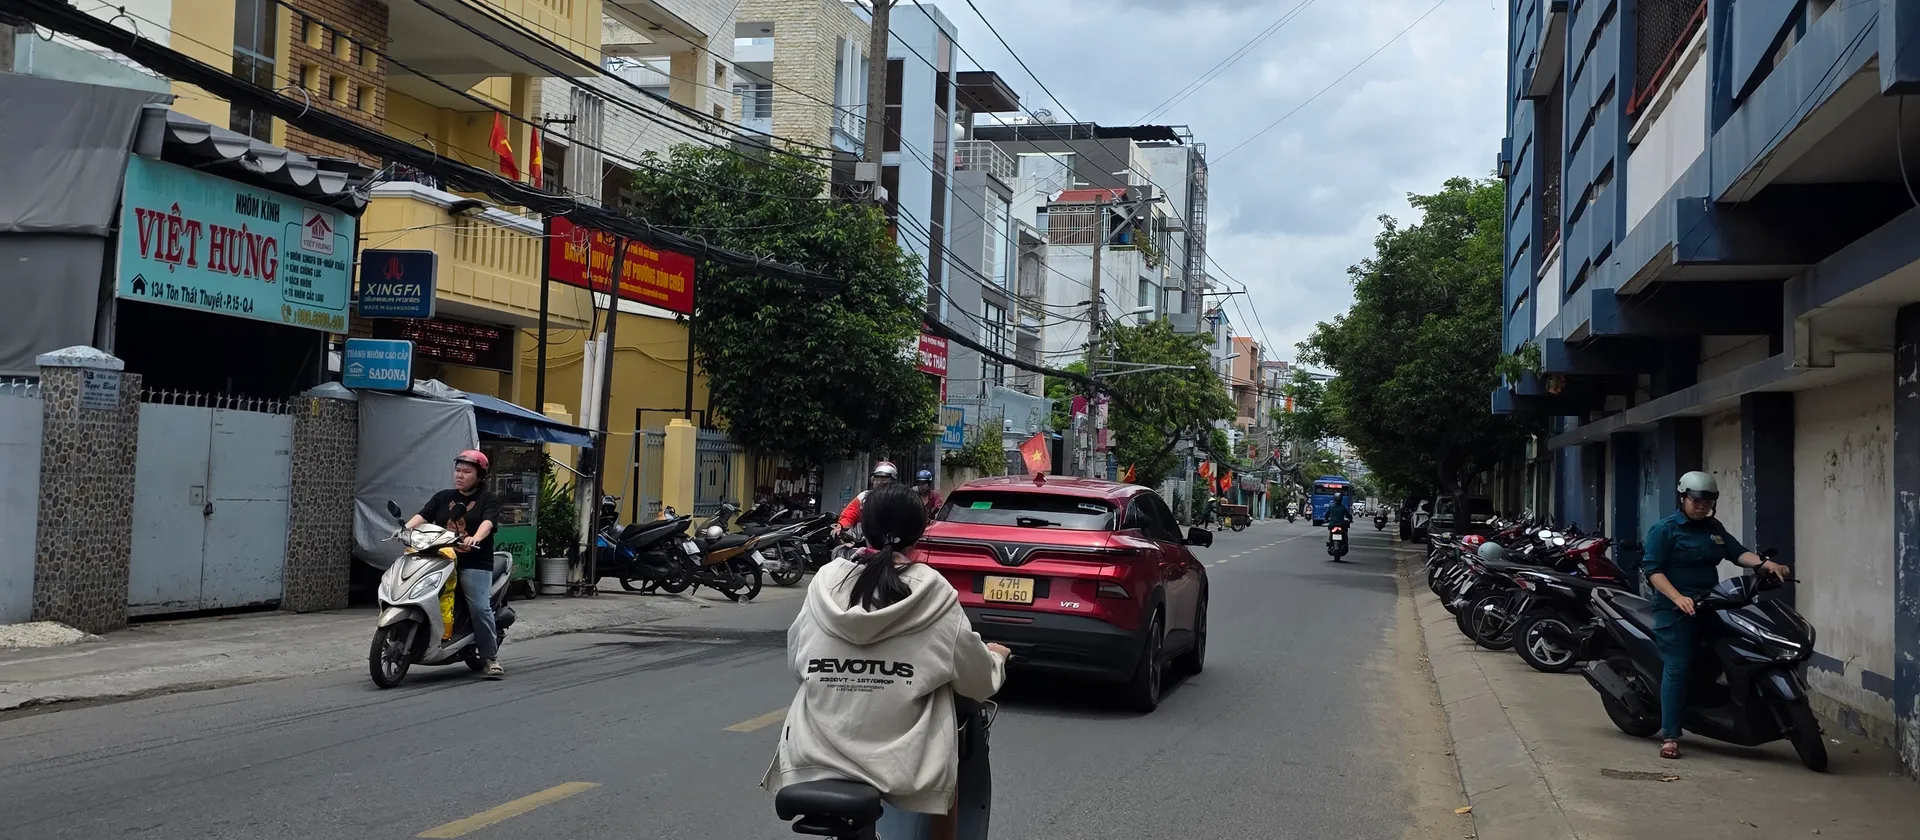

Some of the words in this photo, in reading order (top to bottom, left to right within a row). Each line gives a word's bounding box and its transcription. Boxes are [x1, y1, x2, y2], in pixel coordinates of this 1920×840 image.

[235, 193, 259, 218] NHÔM
[260, 196, 280, 223] KÍNH
[135, 201, 204, 273] VIỆT
[207, 223, 279, 284] HƯNG
[303, 239, 315, 248] VIỆT
[151, 281, 164, 298] 134
[166, 283, 179, 300] Tôn
[181, 286, 198, 304] Thất
[365, 283, 421, 296] XINGFA
[347, 349, 366, 359] THANH
[367, 349, 385, 360] NHÔM
[385, 351, 397, 360] CAO
[398, 347, 409, 360] CẤP
[368, 367, 407, 381] SADONA
[998, 578, 1020, 589] 47H
[989, 589, 1028, 602] 101.60
[1060, 601, 1080, 609] VF6
[807, 658, 915, 679] DEVOTUS
